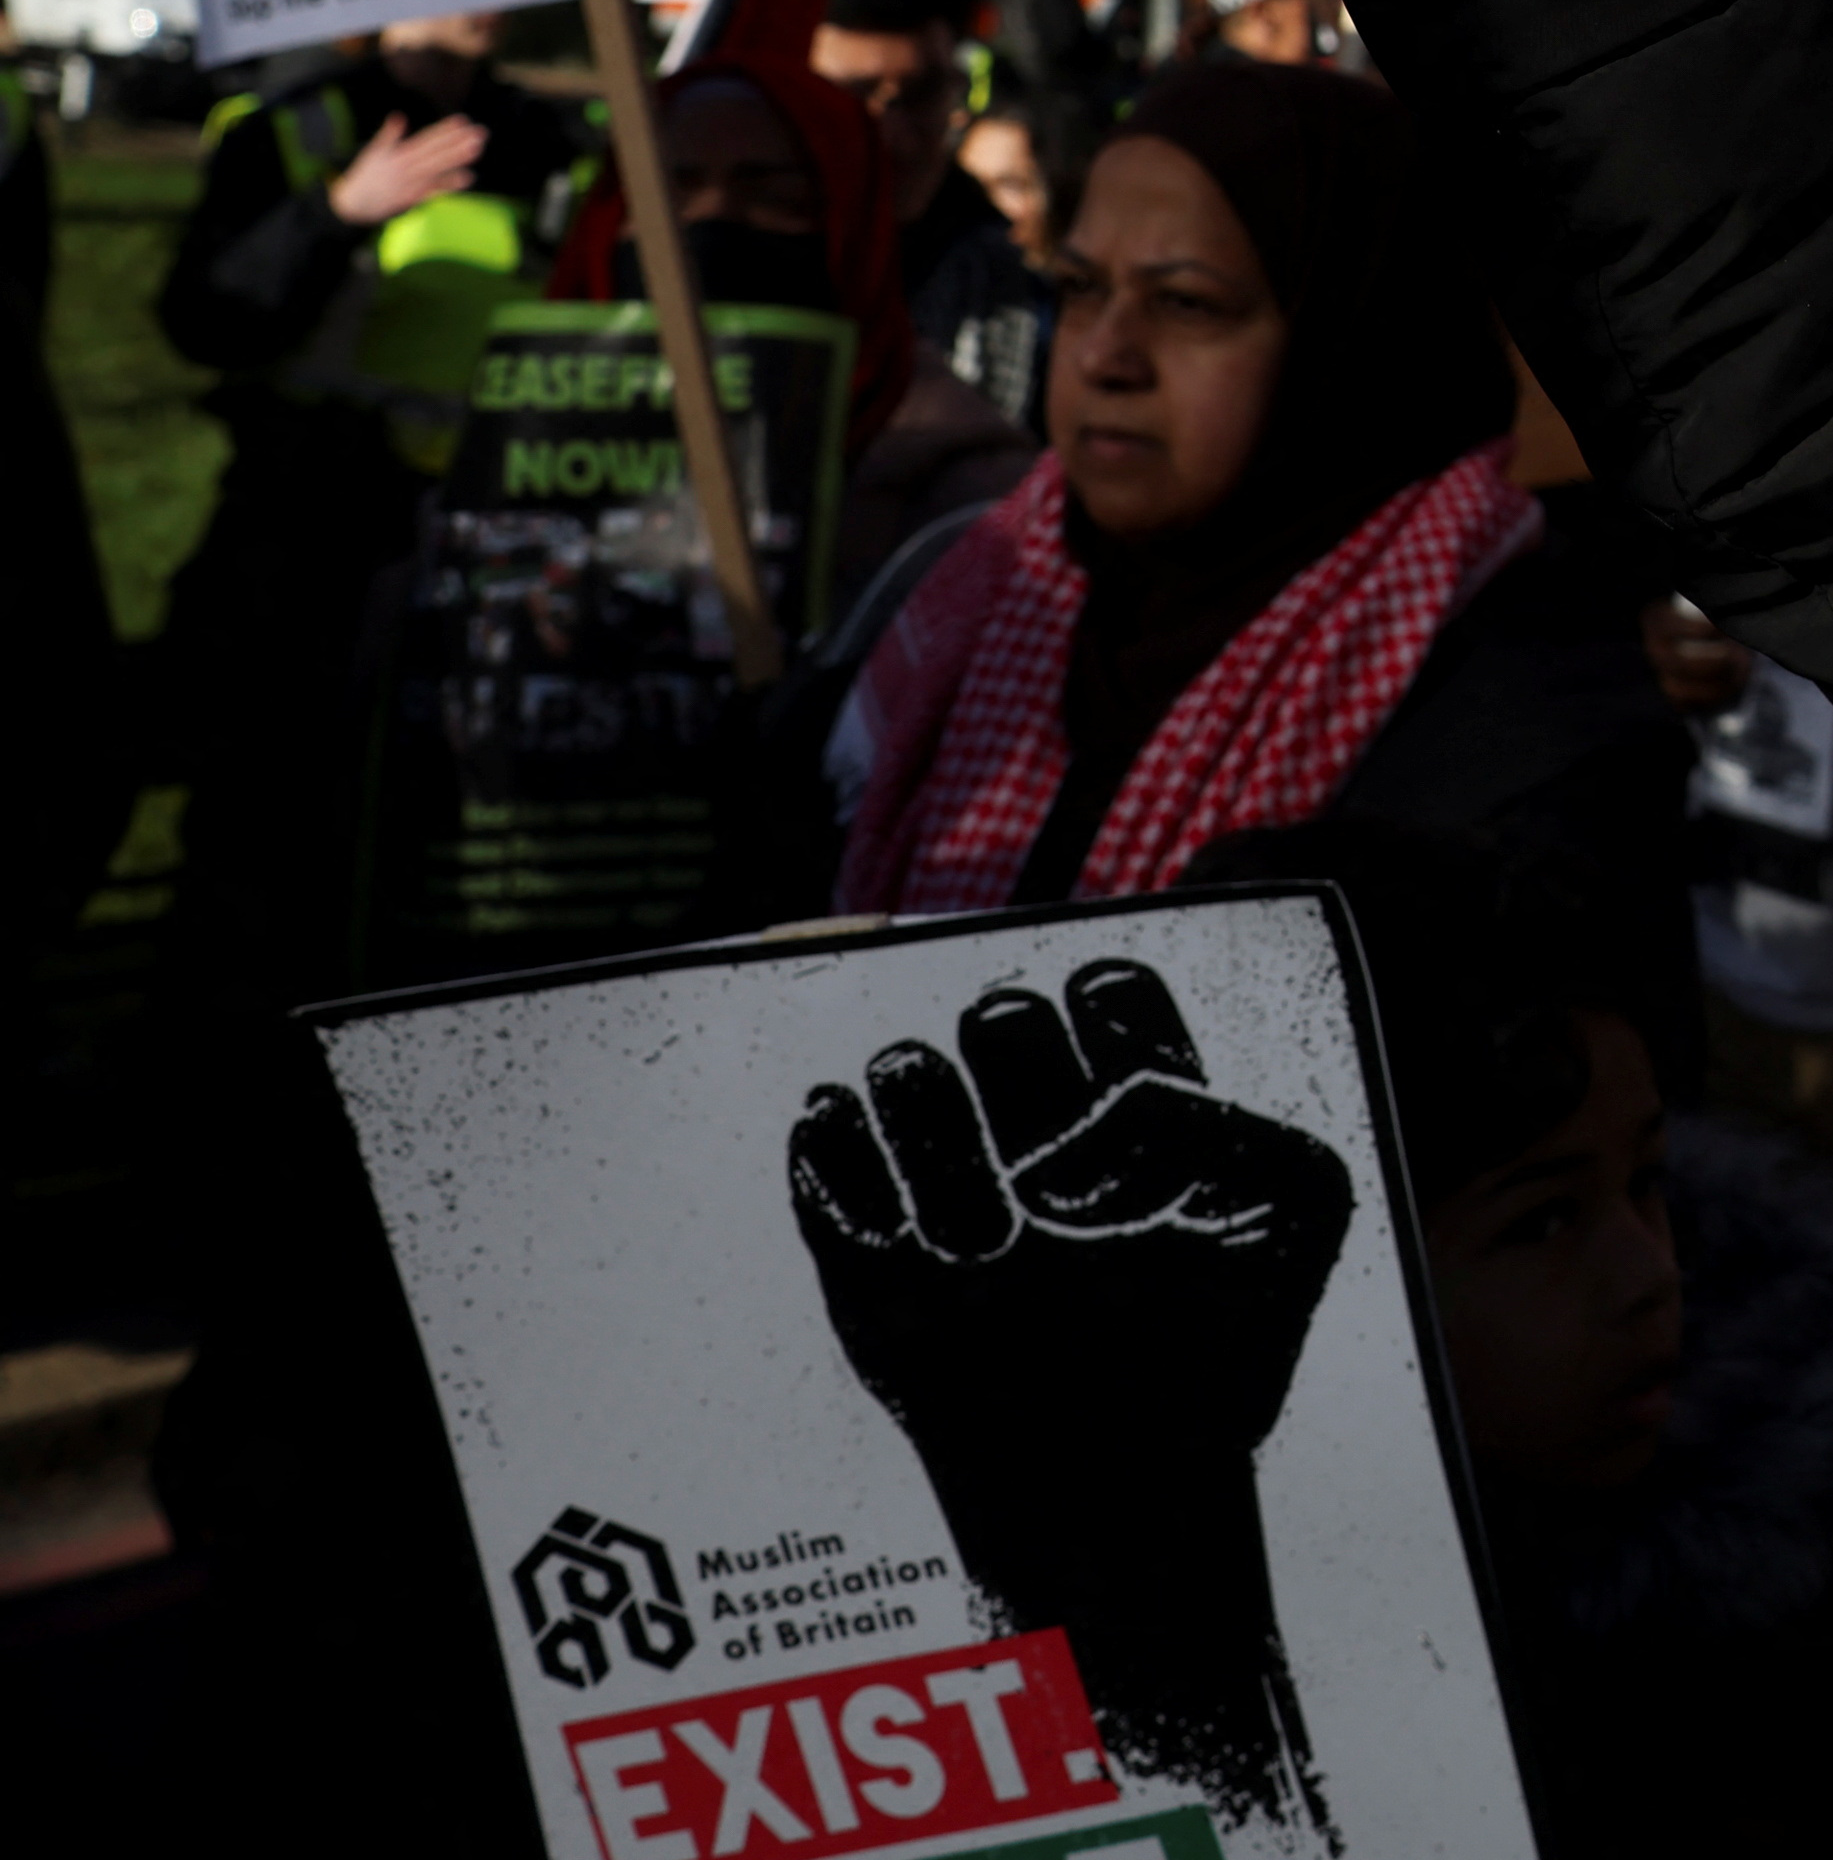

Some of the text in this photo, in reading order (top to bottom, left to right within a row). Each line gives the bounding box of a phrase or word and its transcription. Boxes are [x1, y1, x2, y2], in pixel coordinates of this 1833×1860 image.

[698, 1525, 845, 1583] Muslim
[709, 1551, 949, 1622] Association
[723, 1600, 917, 1666] of Britain
[575, 1656, 1113, 1860] EXIST.
